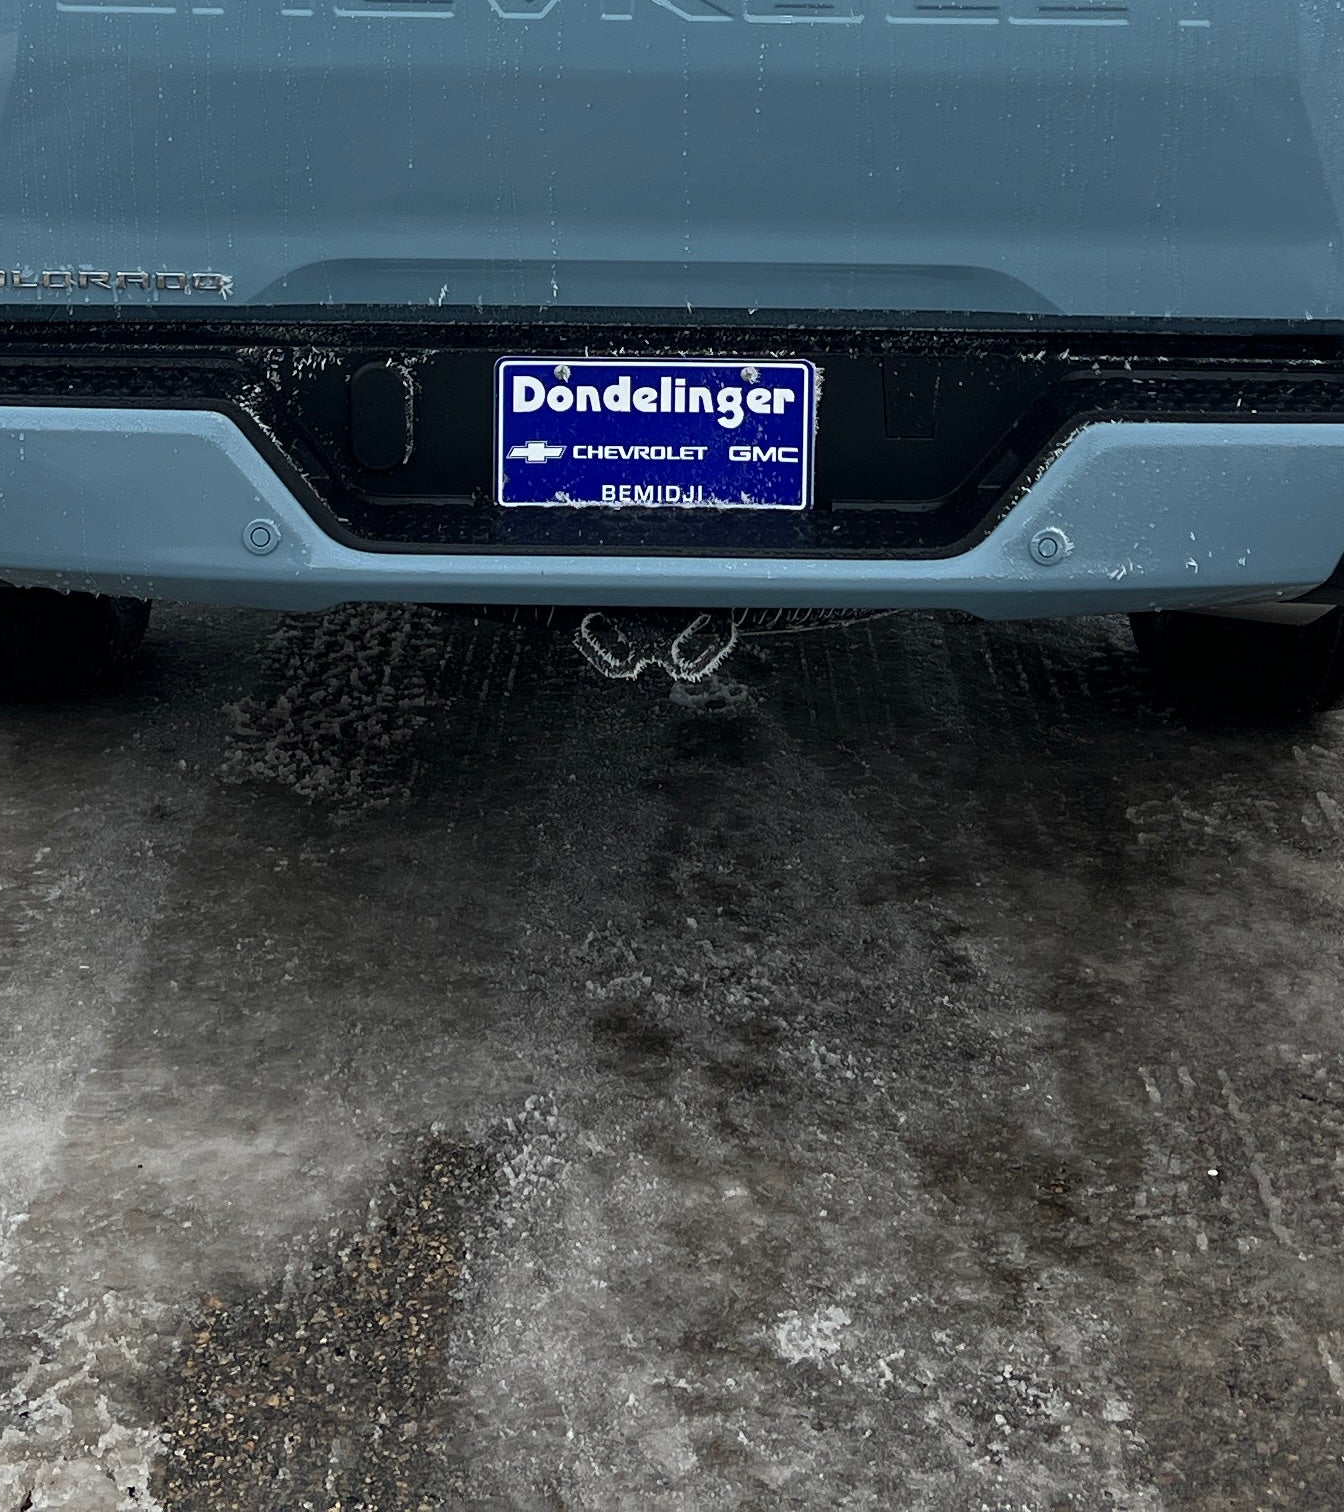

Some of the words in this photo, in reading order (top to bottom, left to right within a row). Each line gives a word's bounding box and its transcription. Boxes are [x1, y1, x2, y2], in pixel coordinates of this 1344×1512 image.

[512, 375, 796, 429] Dondelinger
[572, 445, 708, 461] CHEVROLET
[728, 445, 799, 463] GMC
[601, 484, 704, 503] BEMIDJI
